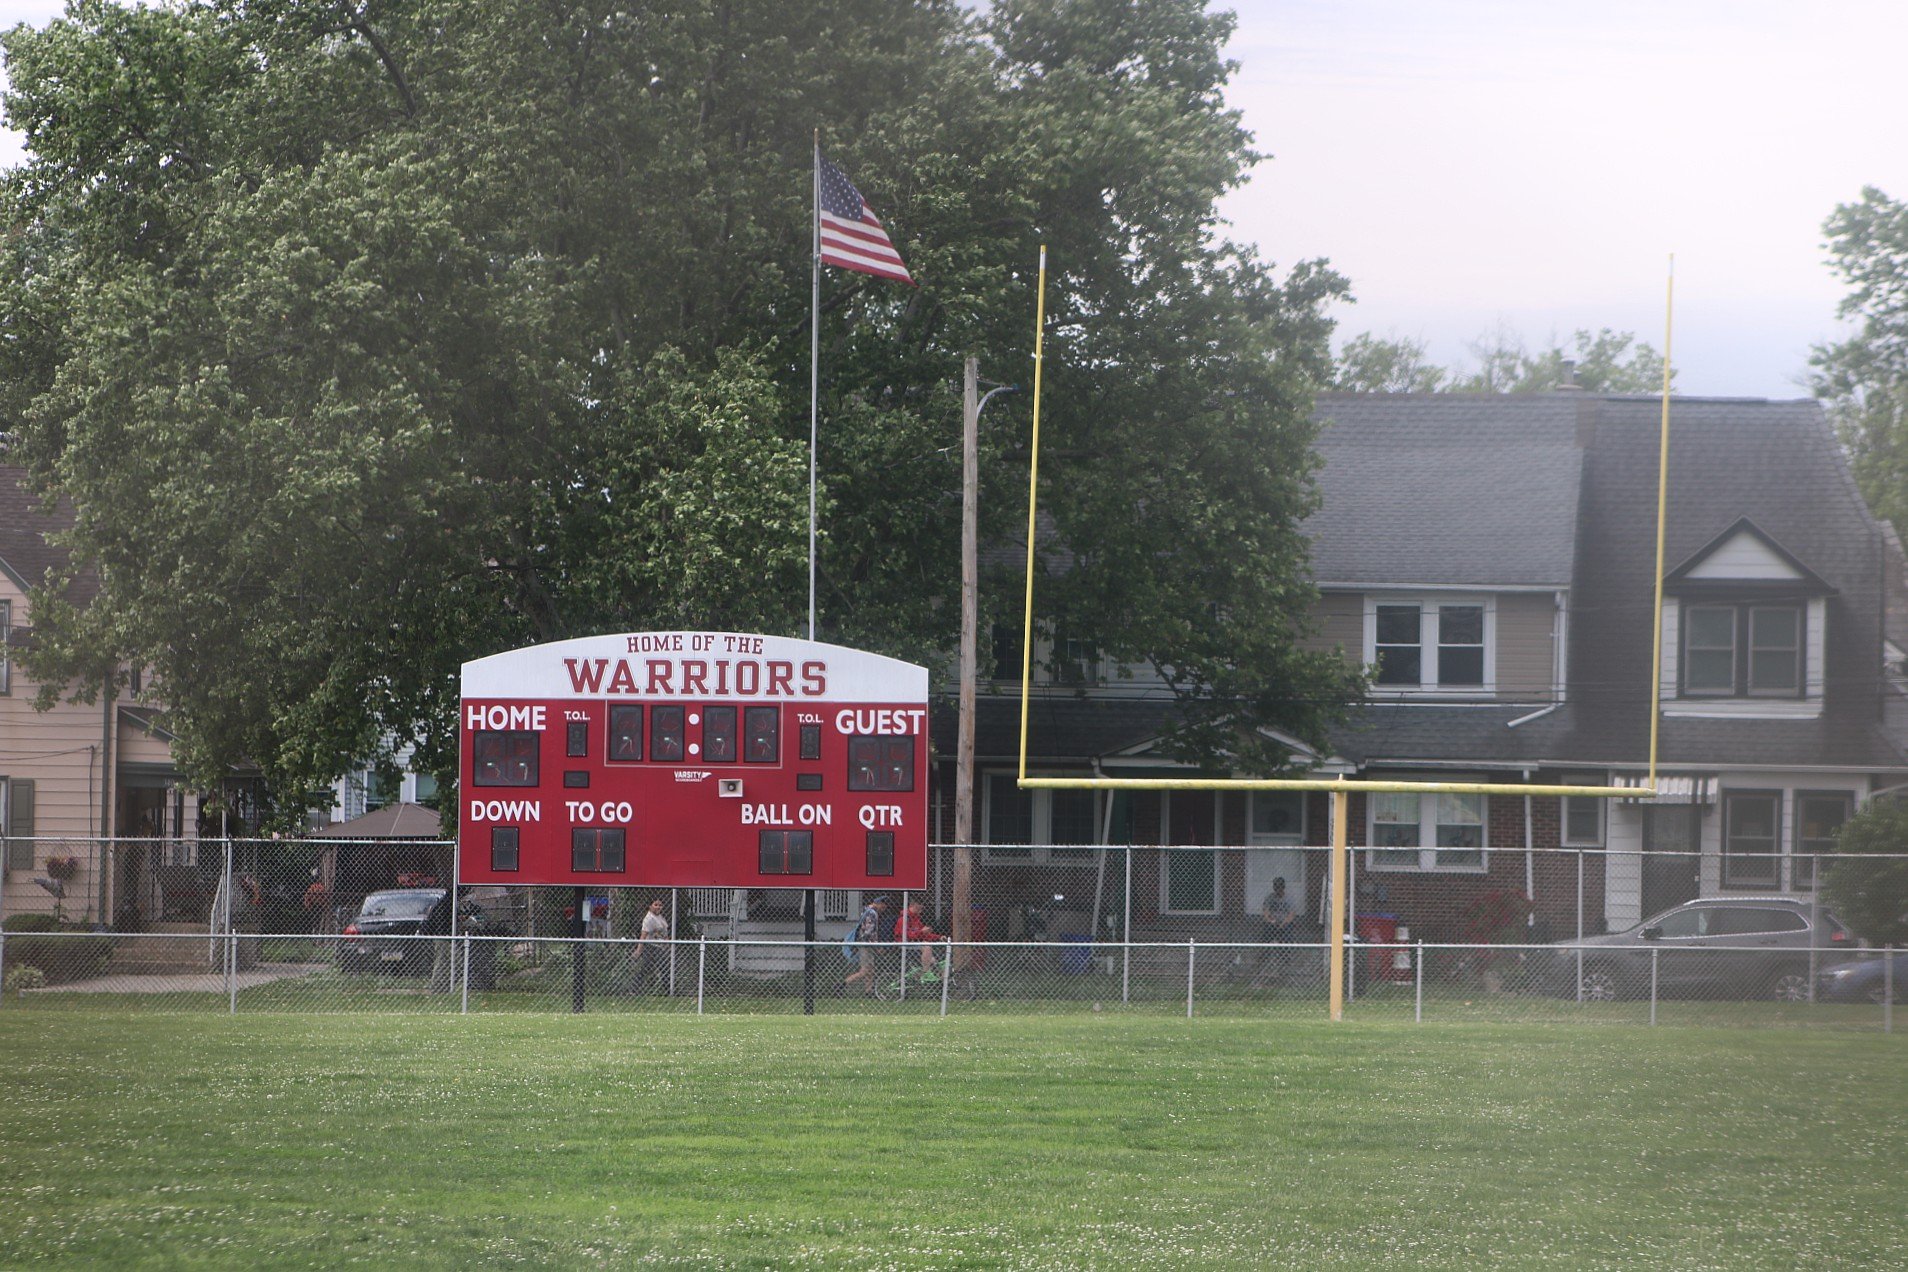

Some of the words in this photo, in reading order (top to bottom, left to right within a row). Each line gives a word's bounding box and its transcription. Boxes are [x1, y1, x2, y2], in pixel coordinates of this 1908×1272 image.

[627, 635, 683, 653] HOME
[692, 635, 715, 652] OF
[724, 636, 764, 654] THE
[563, 657, 827, 696] WARRIORS
[467, 705, 547, 730] HOME
[564, 710, 590, 721] T.O.L.
[797, 713, 824, 724] T.O.L.
[835, 709, 925, 735] GUEST
[674, 770, 702, 779] VARSITY
[471, 800, 540, 822] DOWN
[565, 801, 594, 822] TO
[600, 801, 633, 823] GO
[741, 803, 793, 825] BALL
[798, 803, 831, 826] ON
[858, 805, 903, 830] QTR
